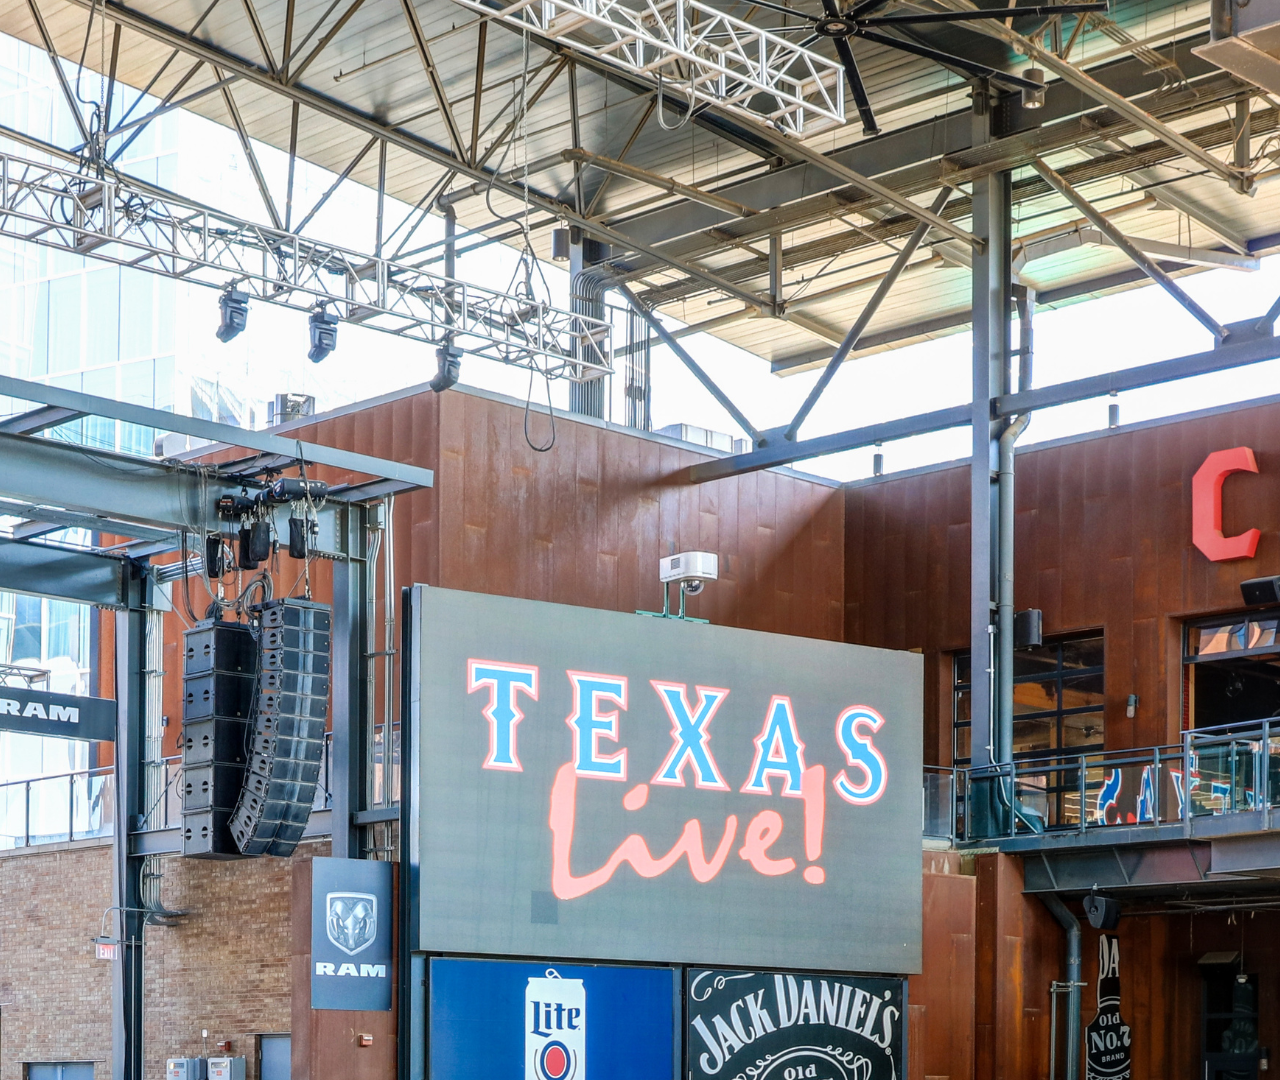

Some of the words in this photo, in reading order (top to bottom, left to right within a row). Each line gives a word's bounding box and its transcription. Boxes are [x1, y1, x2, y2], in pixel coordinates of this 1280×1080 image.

[467, 657, 889, 806] TEXAS
[548, 761, 826, 901] Live!
[315, 961, 387, 978] RAM
[529, 1000, 581, 1039] Lite
[690, 988, 778, 1076] JACK
[773, 973, 901, 1050] DANIEL'S
[1098, 1011, 1120, 1027] Old
[1090, 1024, 1132, 1054] No.7
[1101, 1052, 1125, 1063] BRAND
